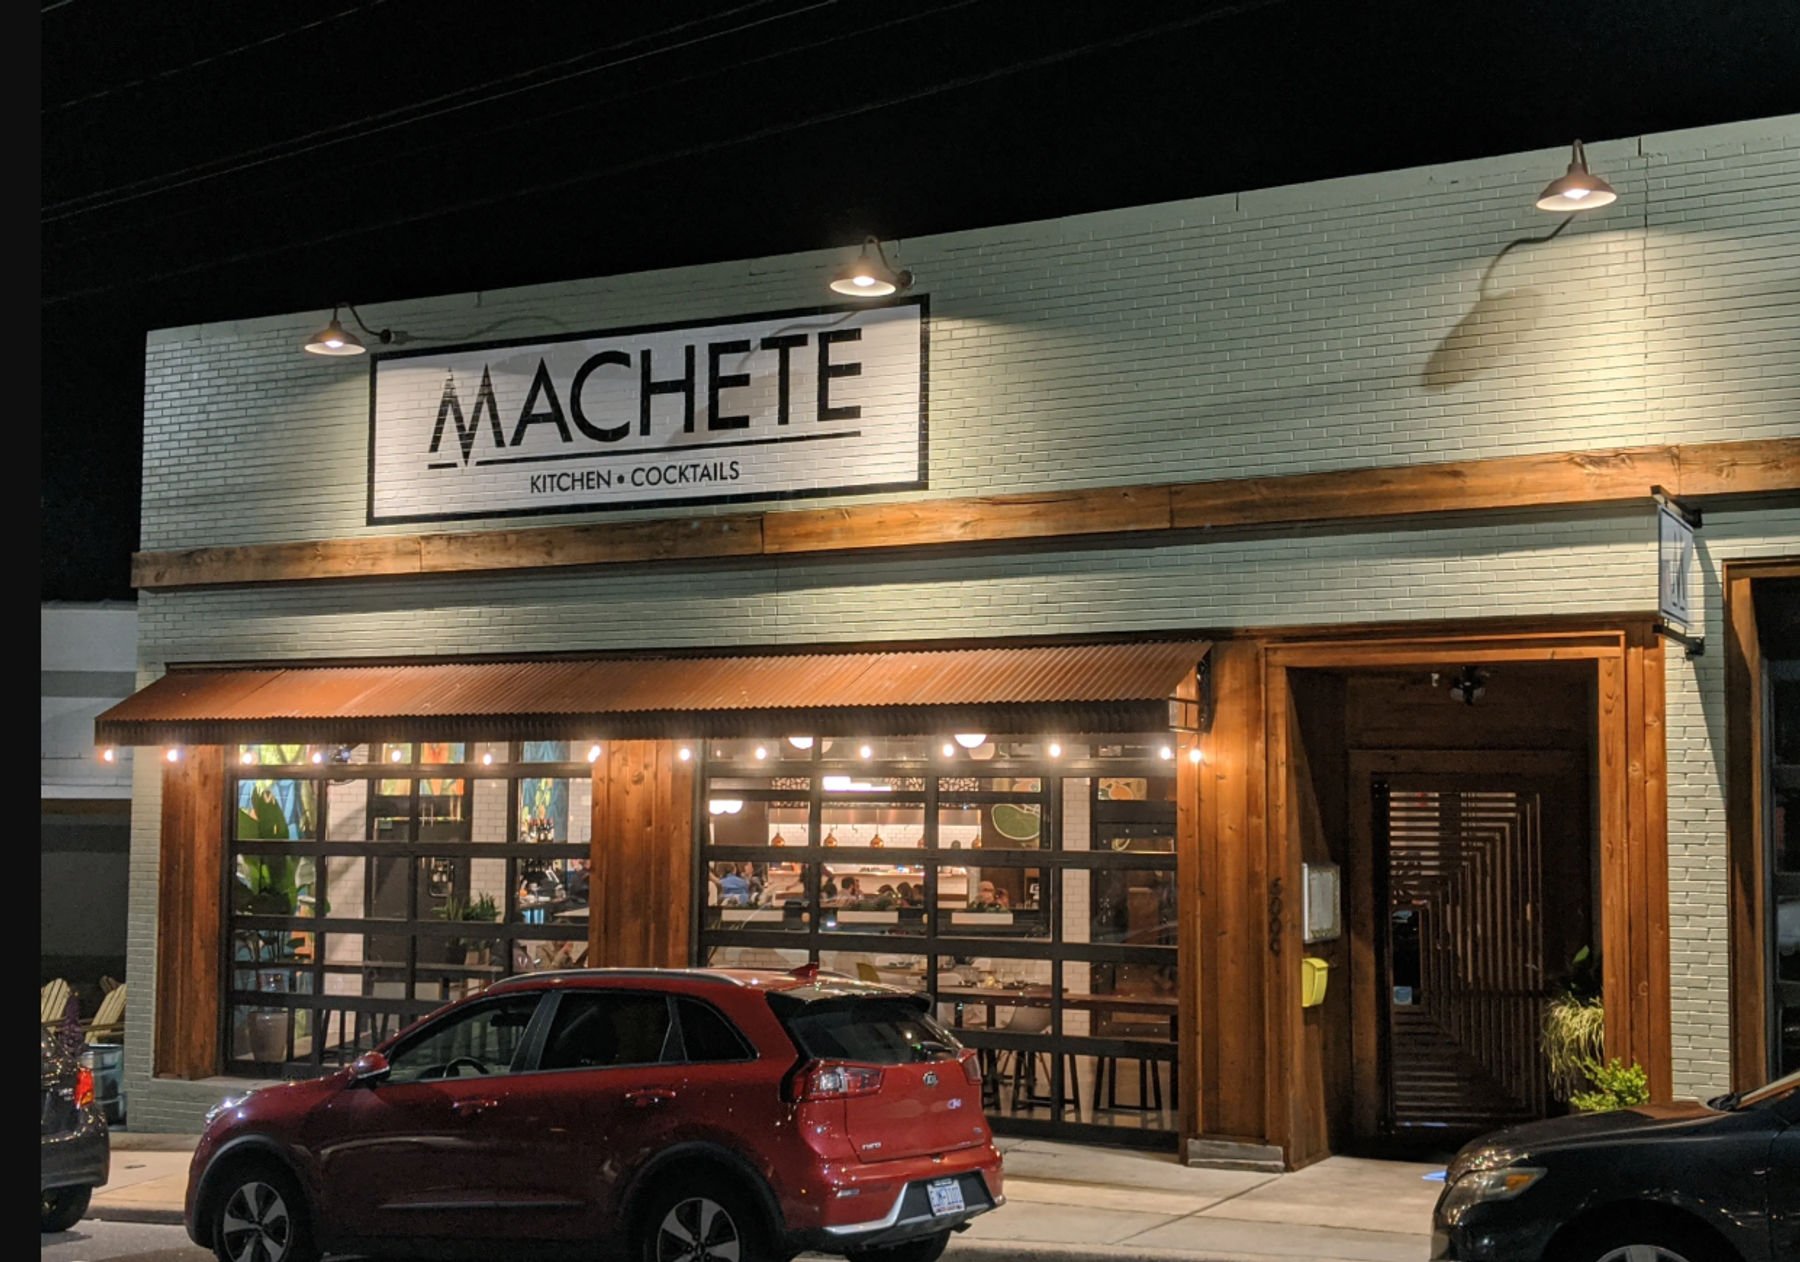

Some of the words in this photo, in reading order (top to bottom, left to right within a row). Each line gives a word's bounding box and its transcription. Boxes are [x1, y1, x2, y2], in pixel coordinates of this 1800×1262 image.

[428, 327, 862, 467] MACHETE
[530, 469, 612, 494] KITCHEN
[631, 461, 740, 487] COCKTAILS
